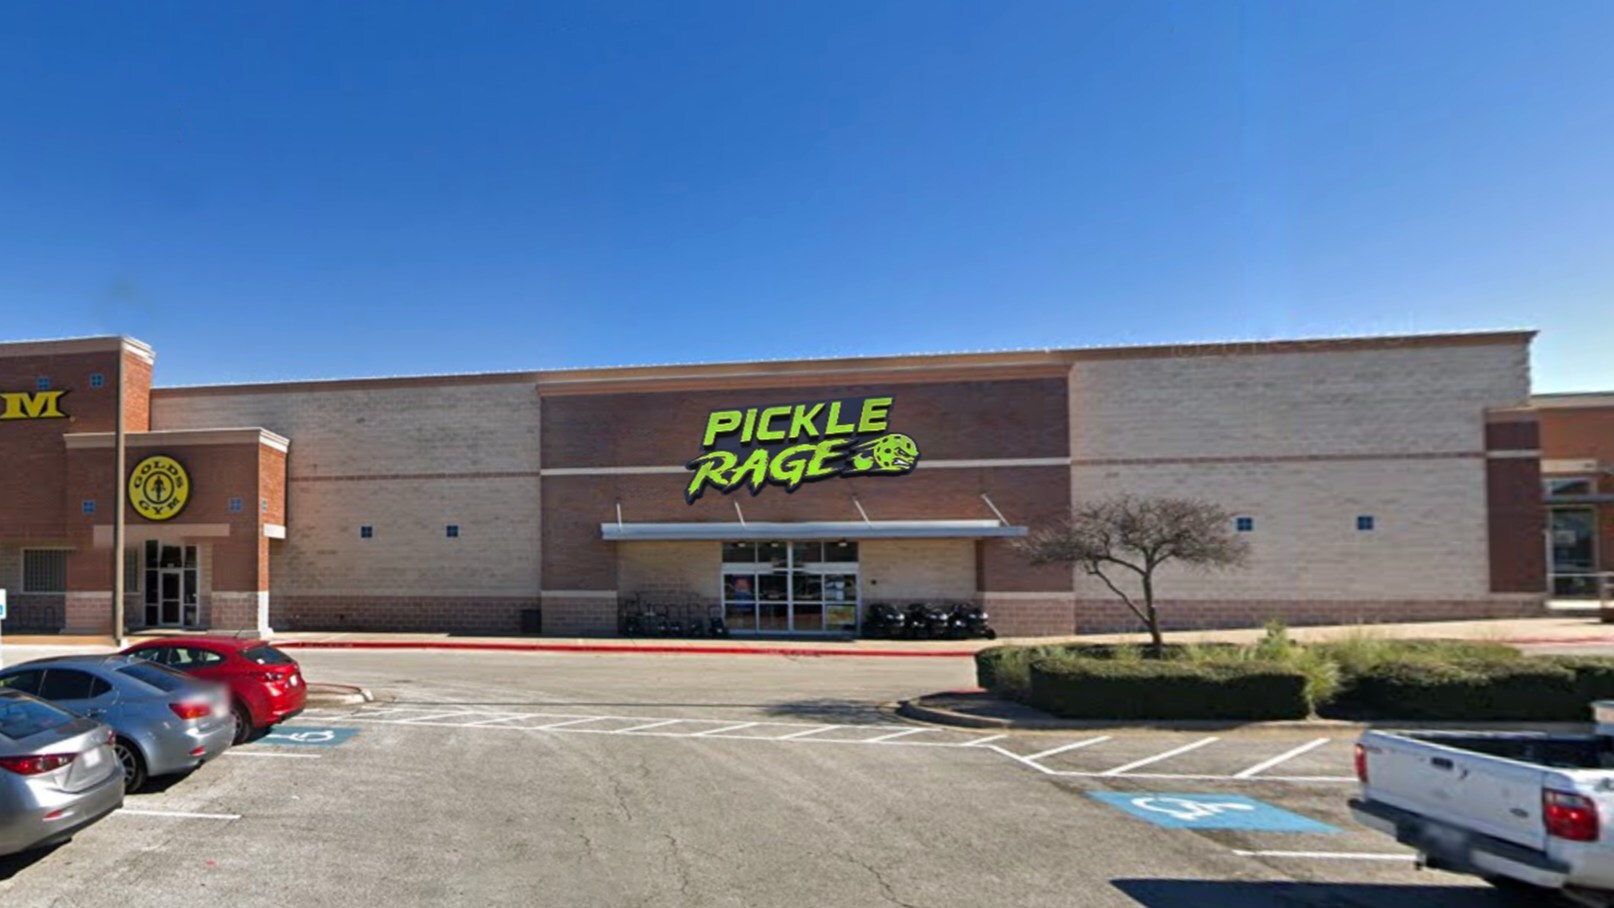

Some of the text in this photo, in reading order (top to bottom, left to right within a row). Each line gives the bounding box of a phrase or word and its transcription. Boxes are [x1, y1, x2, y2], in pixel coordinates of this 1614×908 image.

[703, 396, 893, 447] PICKLE
[688, 438, 853, 496] RAGE
[138, 496, 180, 514] GYM
